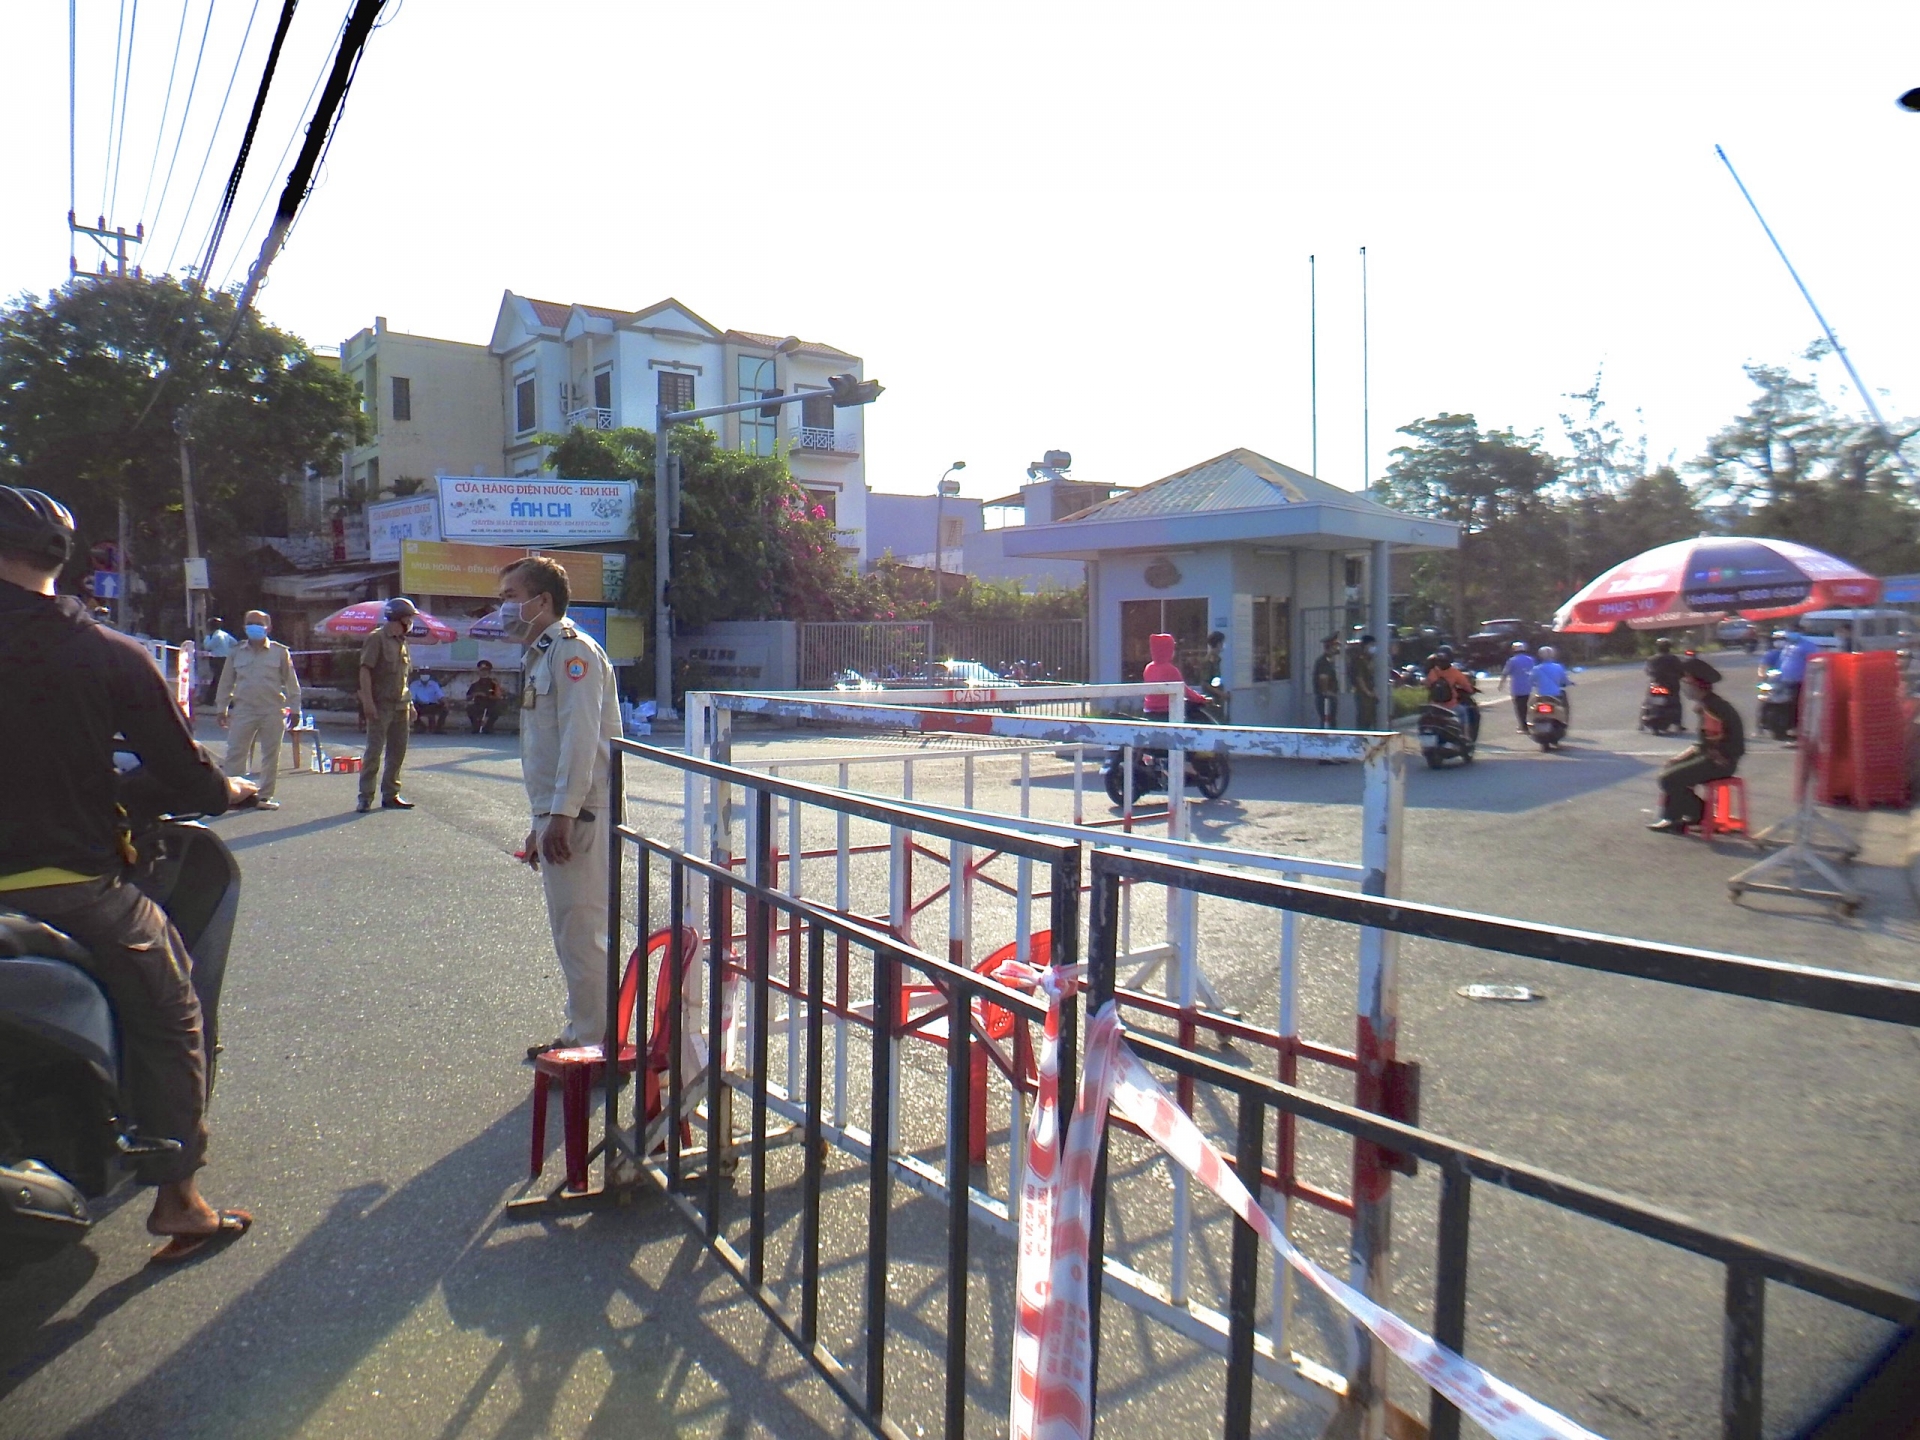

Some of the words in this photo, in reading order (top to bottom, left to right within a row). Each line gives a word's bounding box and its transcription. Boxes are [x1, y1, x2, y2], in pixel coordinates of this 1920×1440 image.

[455, 481, 479, 493] CỬA
[482, 483, 514, 494] HÀNG
[516, 484, 542, 497] ĐIỆN
[543, 485, 573, 495] NƯỚC
[580, 486, 599, 496] KIM
[601, 485, 619, 496] KHÍ
[547, 501, 572, 518] CHI
[432, 563, 461, 572] HONDA
[1598, 601, 1633, 615] PHỤC
[1637, 598, 1655, 611] VỤ
